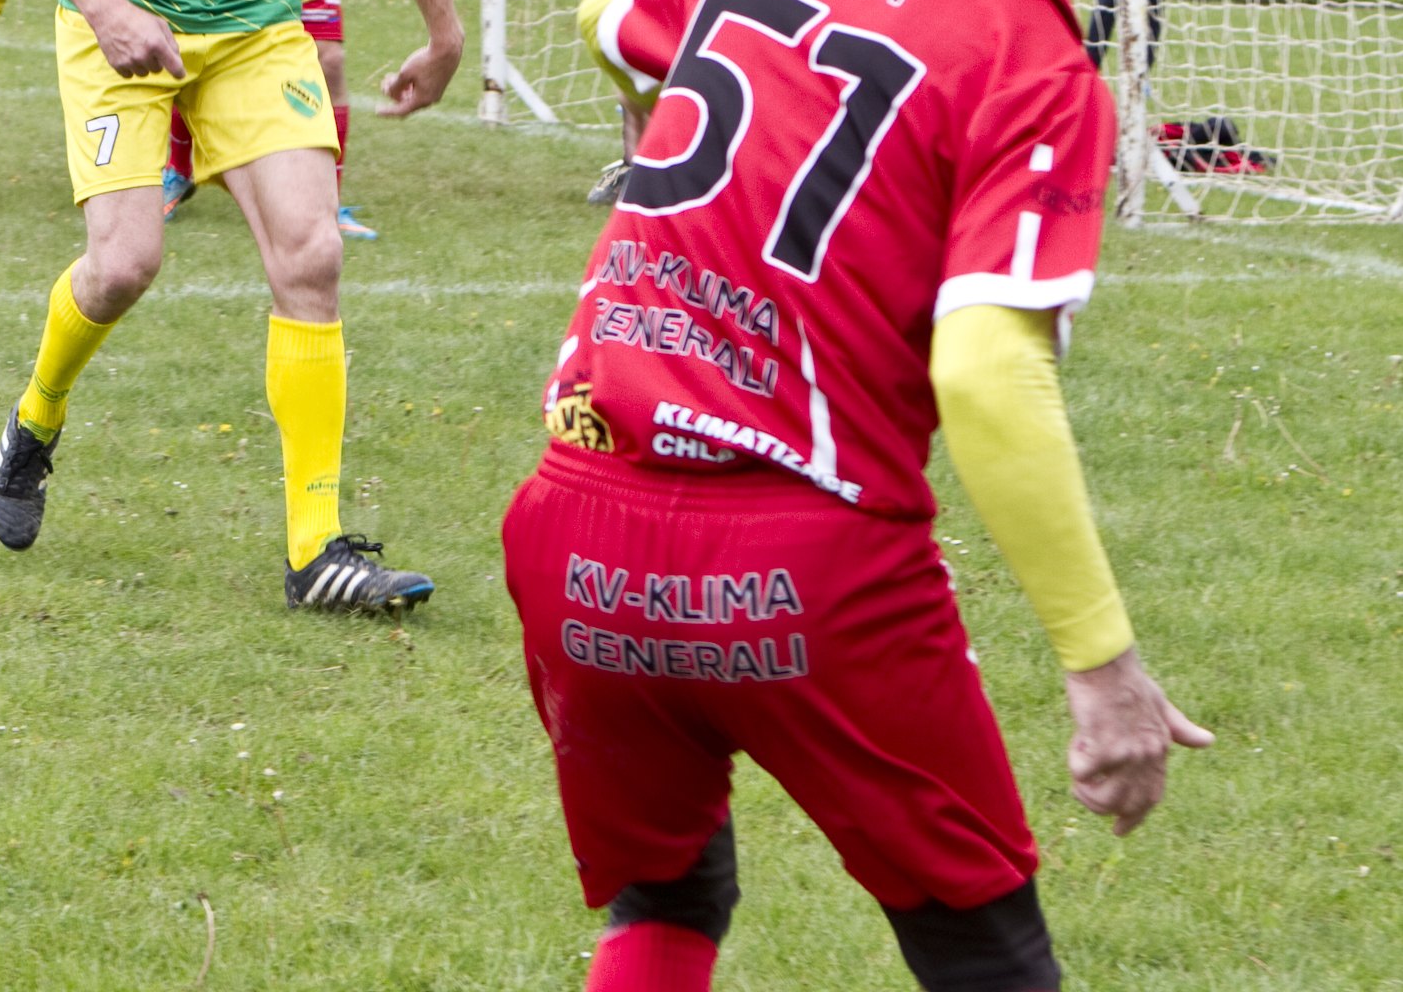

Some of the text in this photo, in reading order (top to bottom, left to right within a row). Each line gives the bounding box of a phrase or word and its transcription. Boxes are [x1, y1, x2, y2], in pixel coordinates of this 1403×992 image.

[85, 113, 120, 166] 7
[597, 239, 779, 347] KV-KLIMA
[653, 400, 863, 505] KLIMATIZACE
[564, 552, 805, 625] KV-KLIMA
[561, 618, 809, 683] GENERALI
